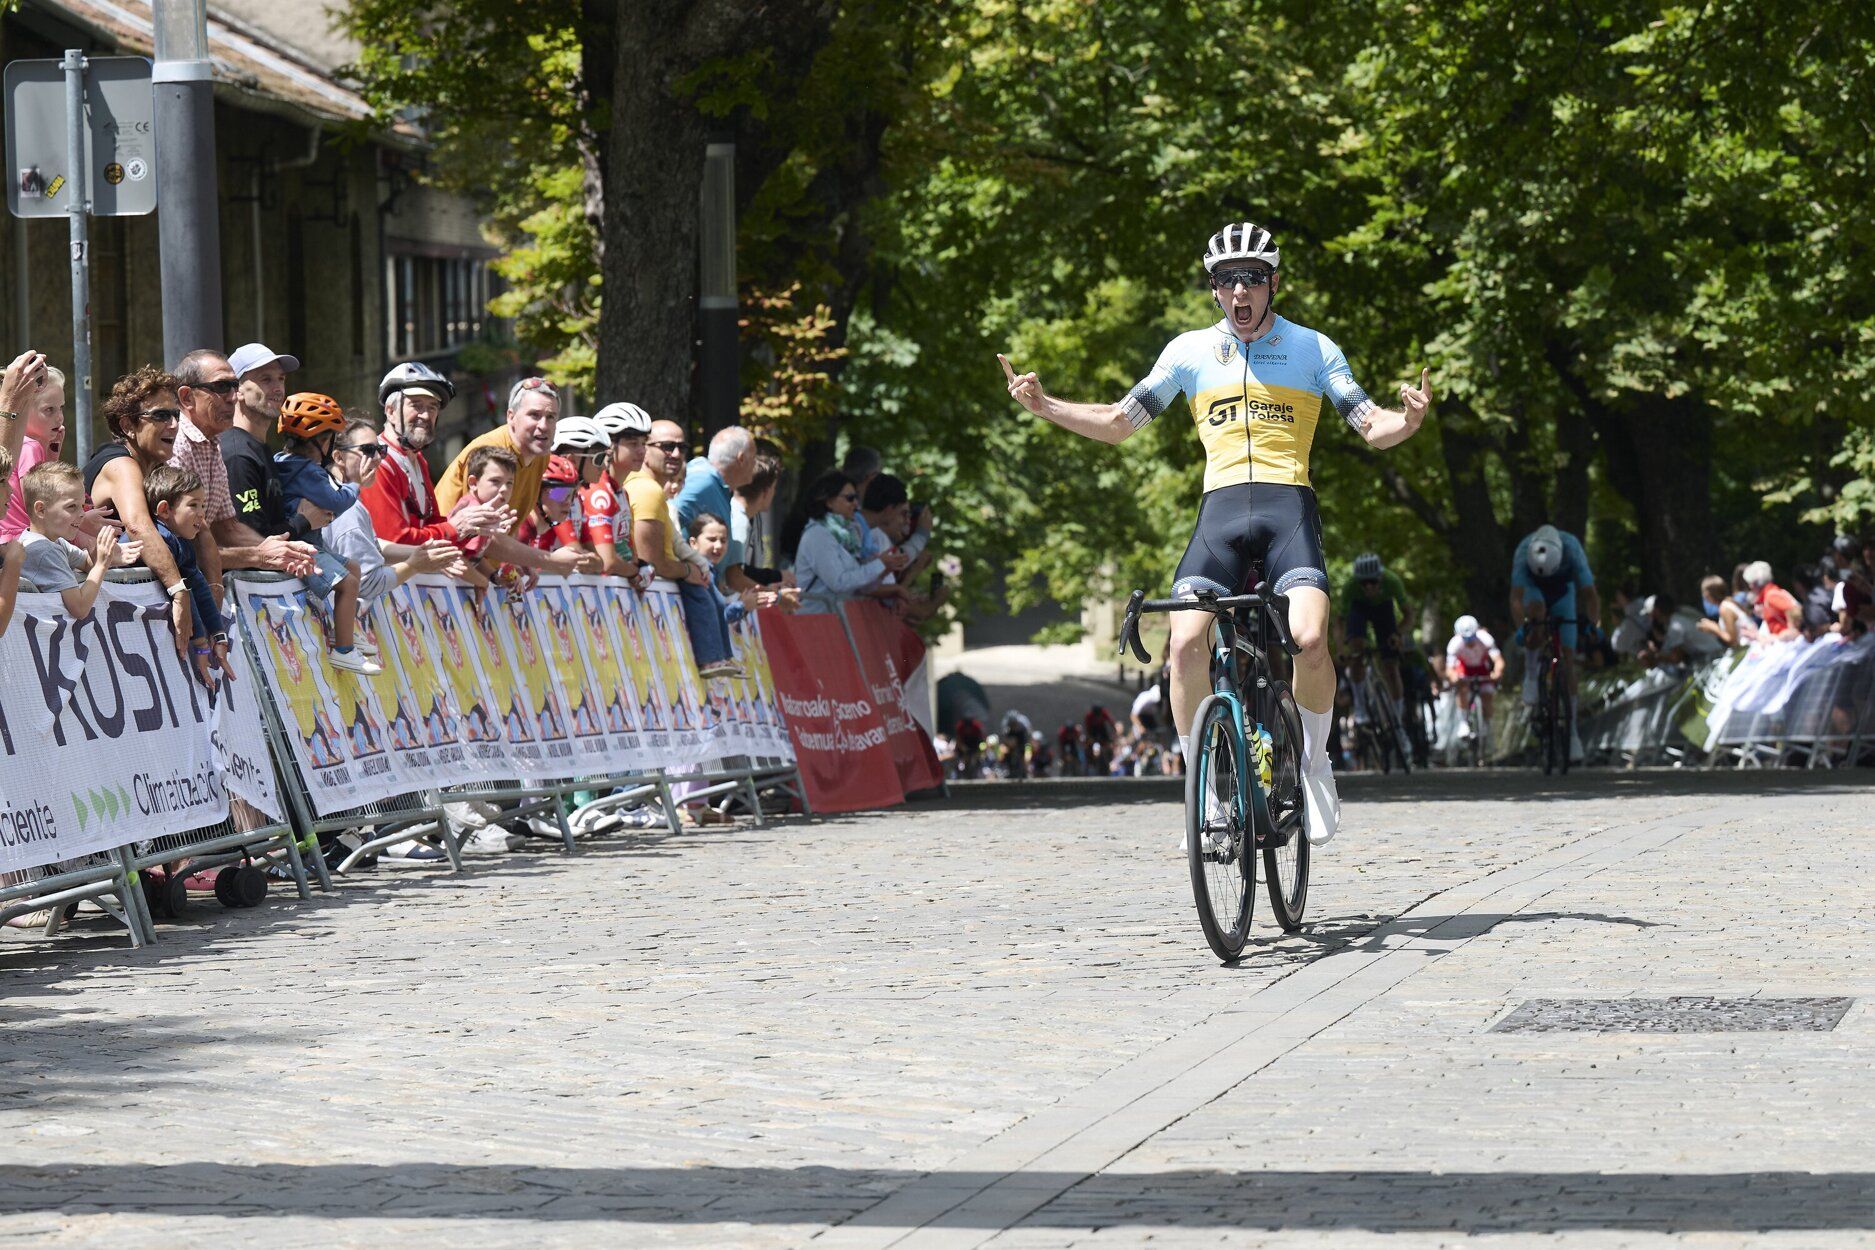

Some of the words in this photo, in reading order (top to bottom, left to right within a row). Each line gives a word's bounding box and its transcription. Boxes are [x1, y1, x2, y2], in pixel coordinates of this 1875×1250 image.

[1209, 395, 1245, 426] GT
[1249, 400, 1294, 413] Garaje
[1249, 410, 1295, 423] Tolosa
[235, 488, 258, 503] VR
[132, 761, 219, 816] Climatizació
